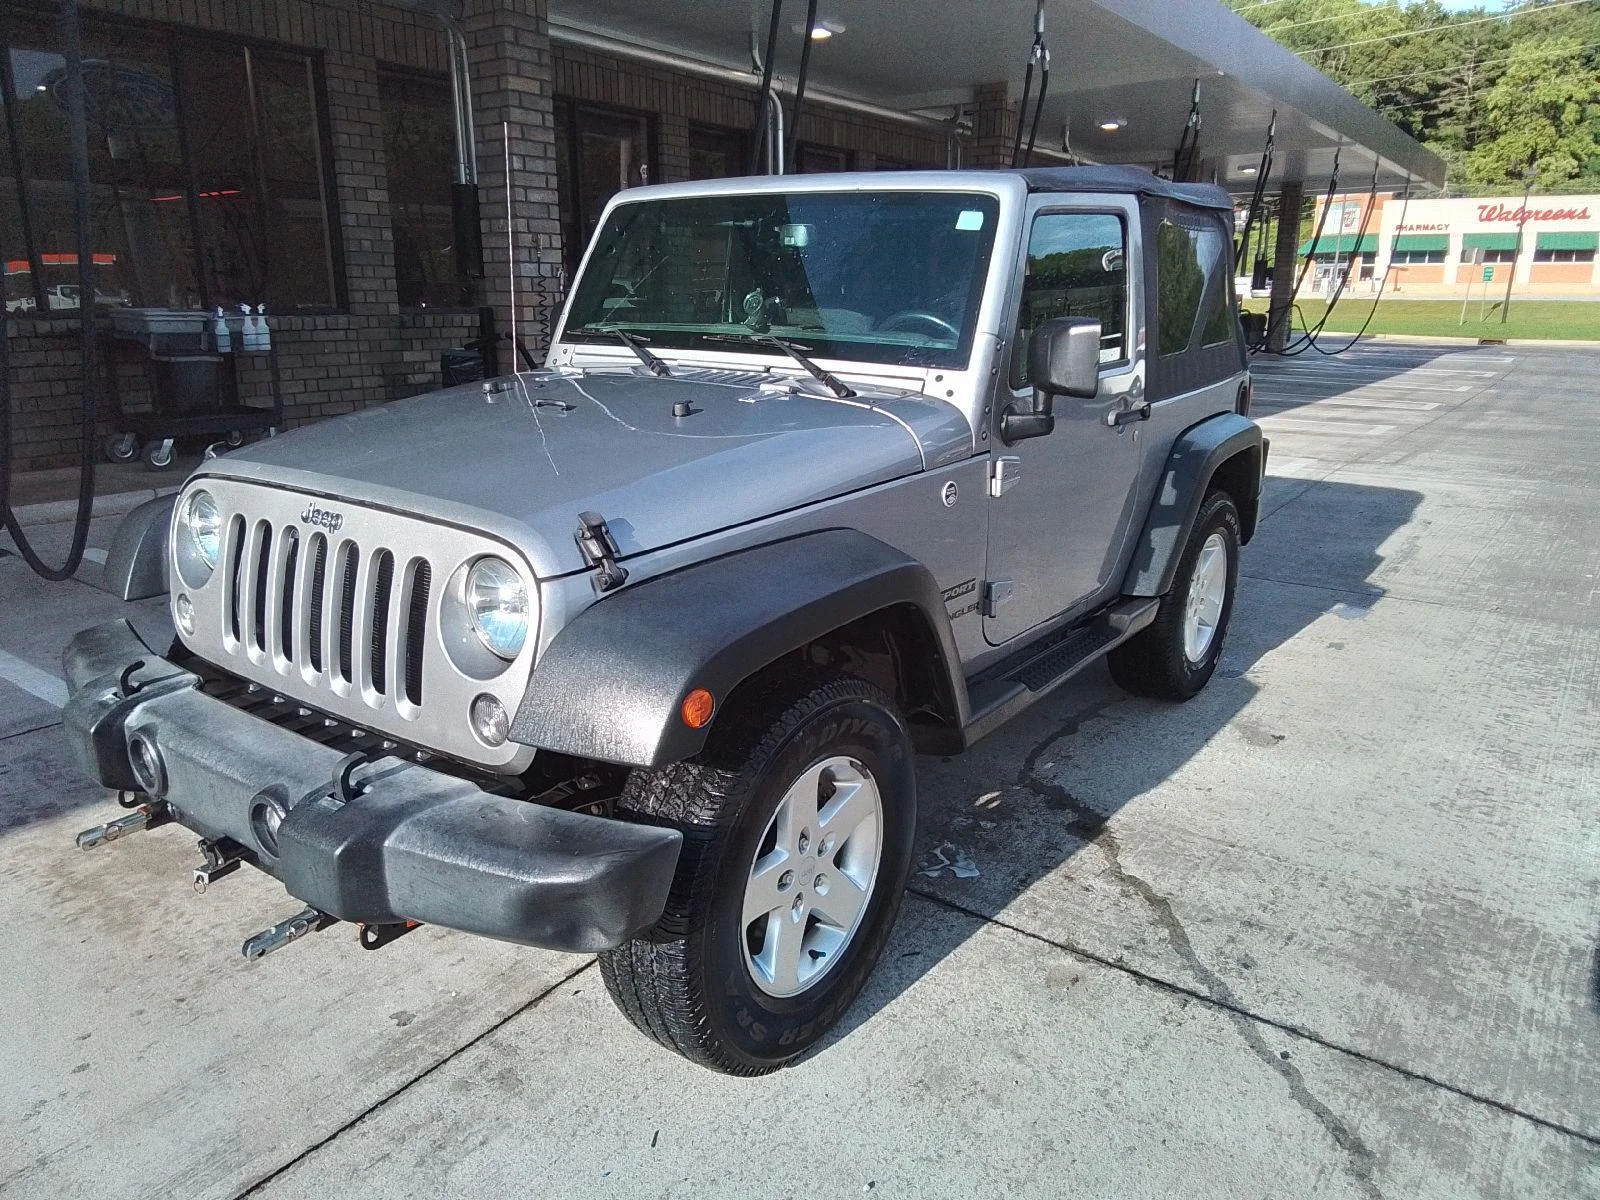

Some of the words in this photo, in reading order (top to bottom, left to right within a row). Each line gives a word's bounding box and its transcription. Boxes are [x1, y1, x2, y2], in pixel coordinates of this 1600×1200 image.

[1477, 203, 1591, 225] Walgreens
[1395, 223, 1450, 232] PHARMACY
[301, 502, 344, 534] Jeep
[942, 581, 976, 600] PORT
